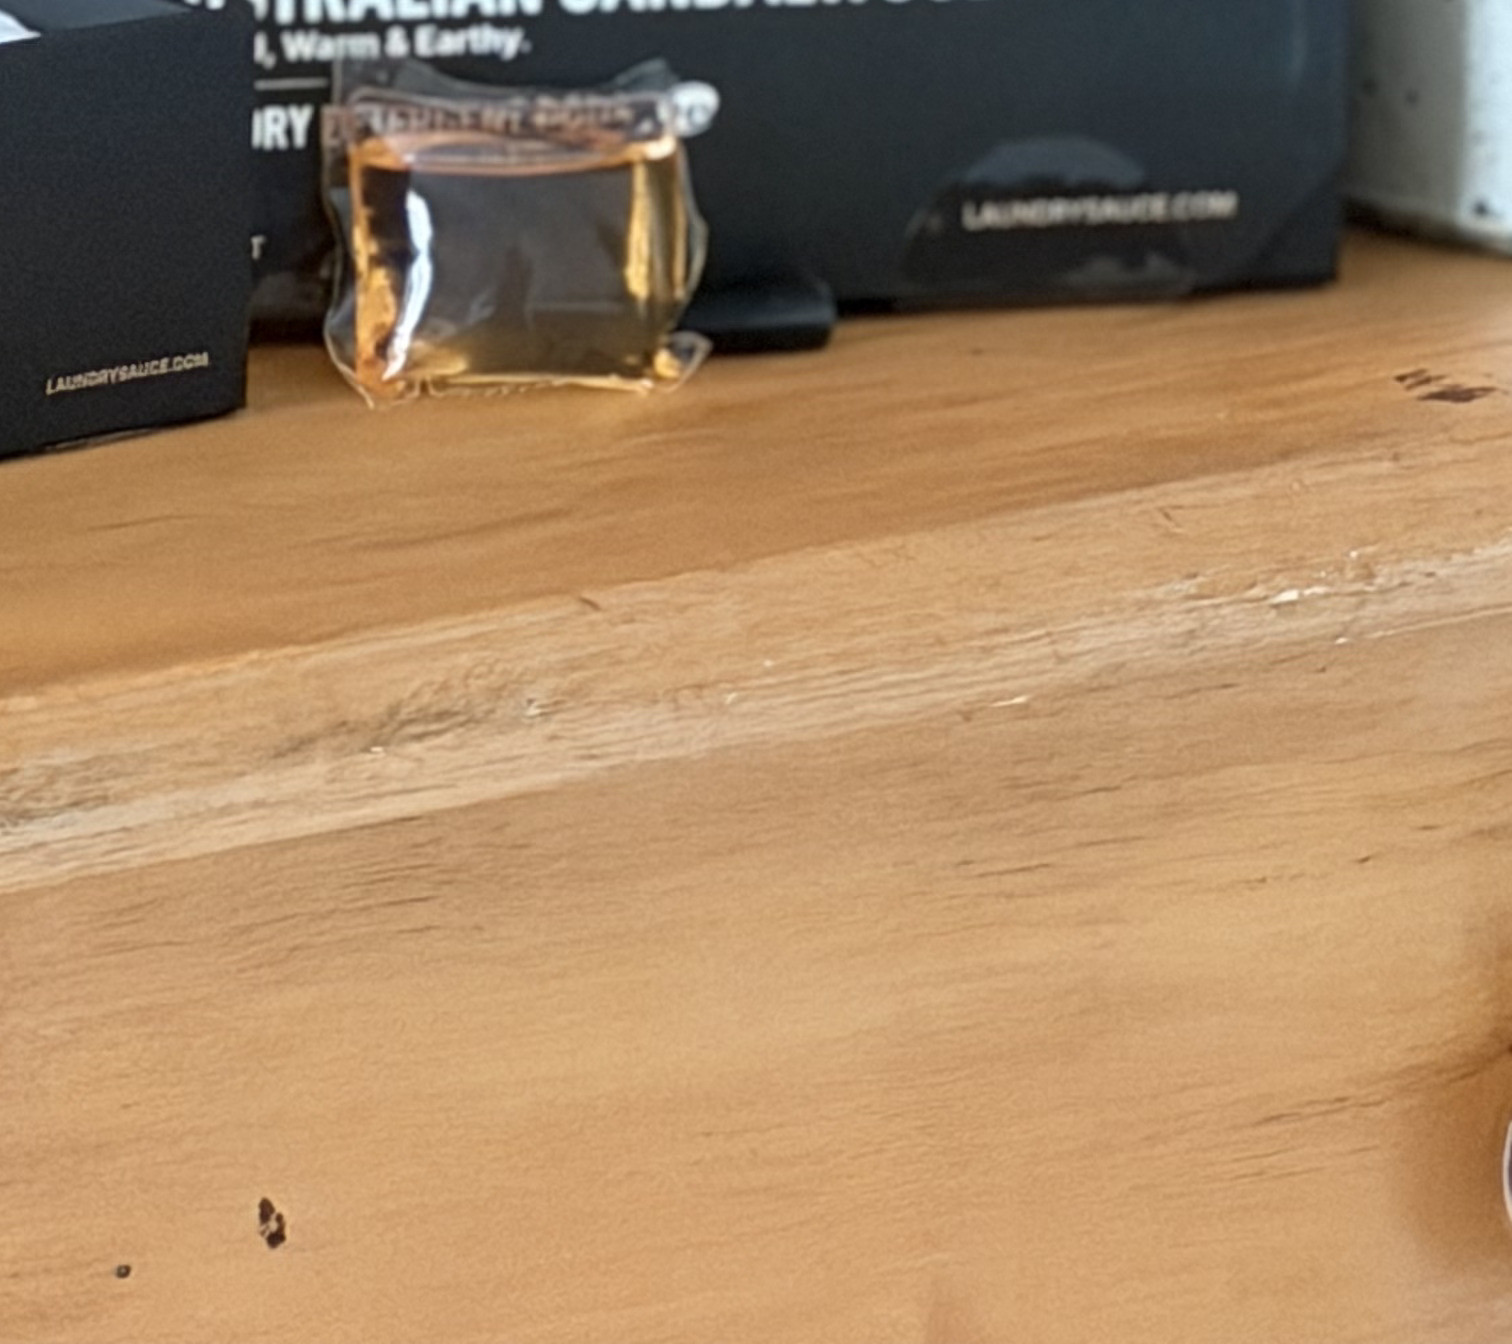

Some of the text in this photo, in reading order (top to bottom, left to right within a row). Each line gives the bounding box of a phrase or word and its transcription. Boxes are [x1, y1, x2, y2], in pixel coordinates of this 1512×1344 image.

[281, 30, 381, 63] Warm
[384, 25, 411, 60] &
[414, 21, 531, 62] Earthy.
[45, 351, 209, 396] LAUNDRYSAUCE.COM
